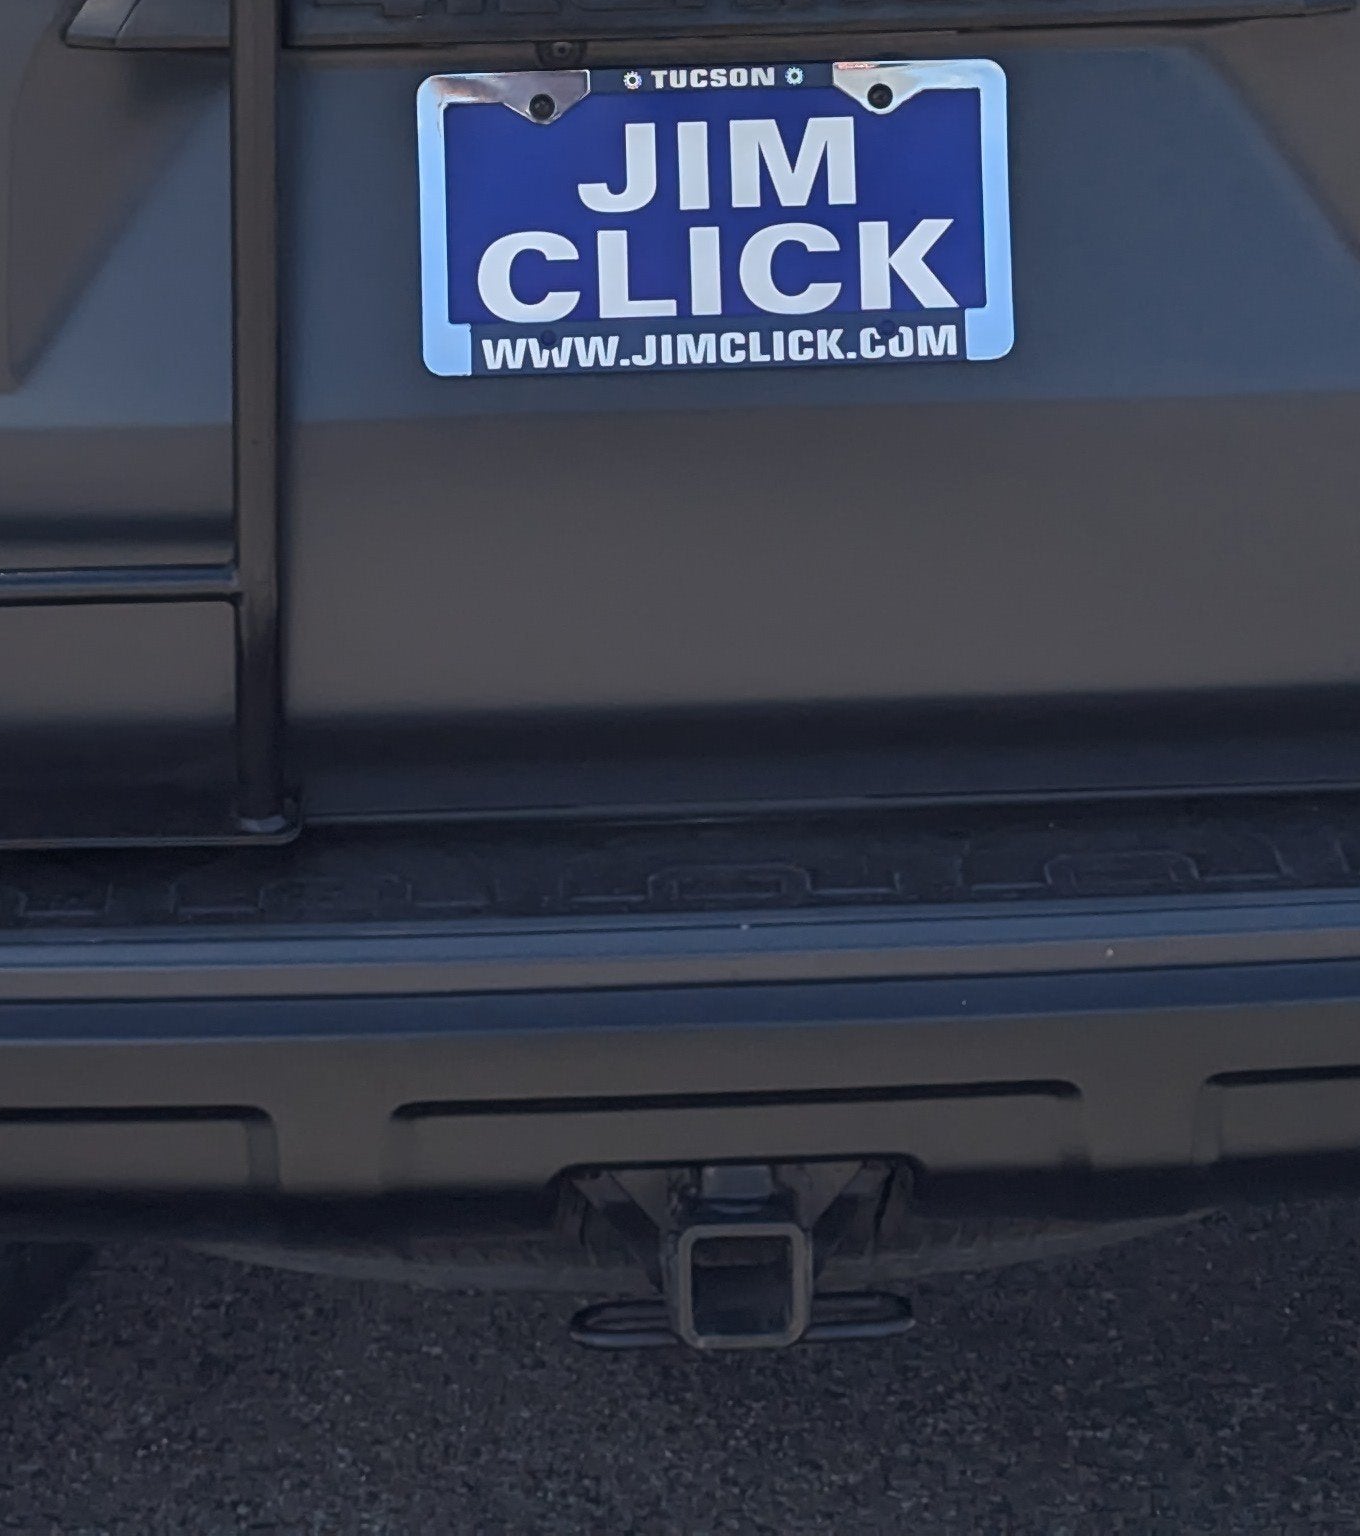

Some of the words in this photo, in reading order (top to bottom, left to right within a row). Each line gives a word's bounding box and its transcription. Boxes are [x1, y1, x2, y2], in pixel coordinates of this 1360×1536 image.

[650, 66, 775, 89] TUCSON
[577, 116, 857, 213] JIM
[477, 218, 960, 323] CLICK
[481, 324, 958, 370] WWW.JIMCLICK.COM
